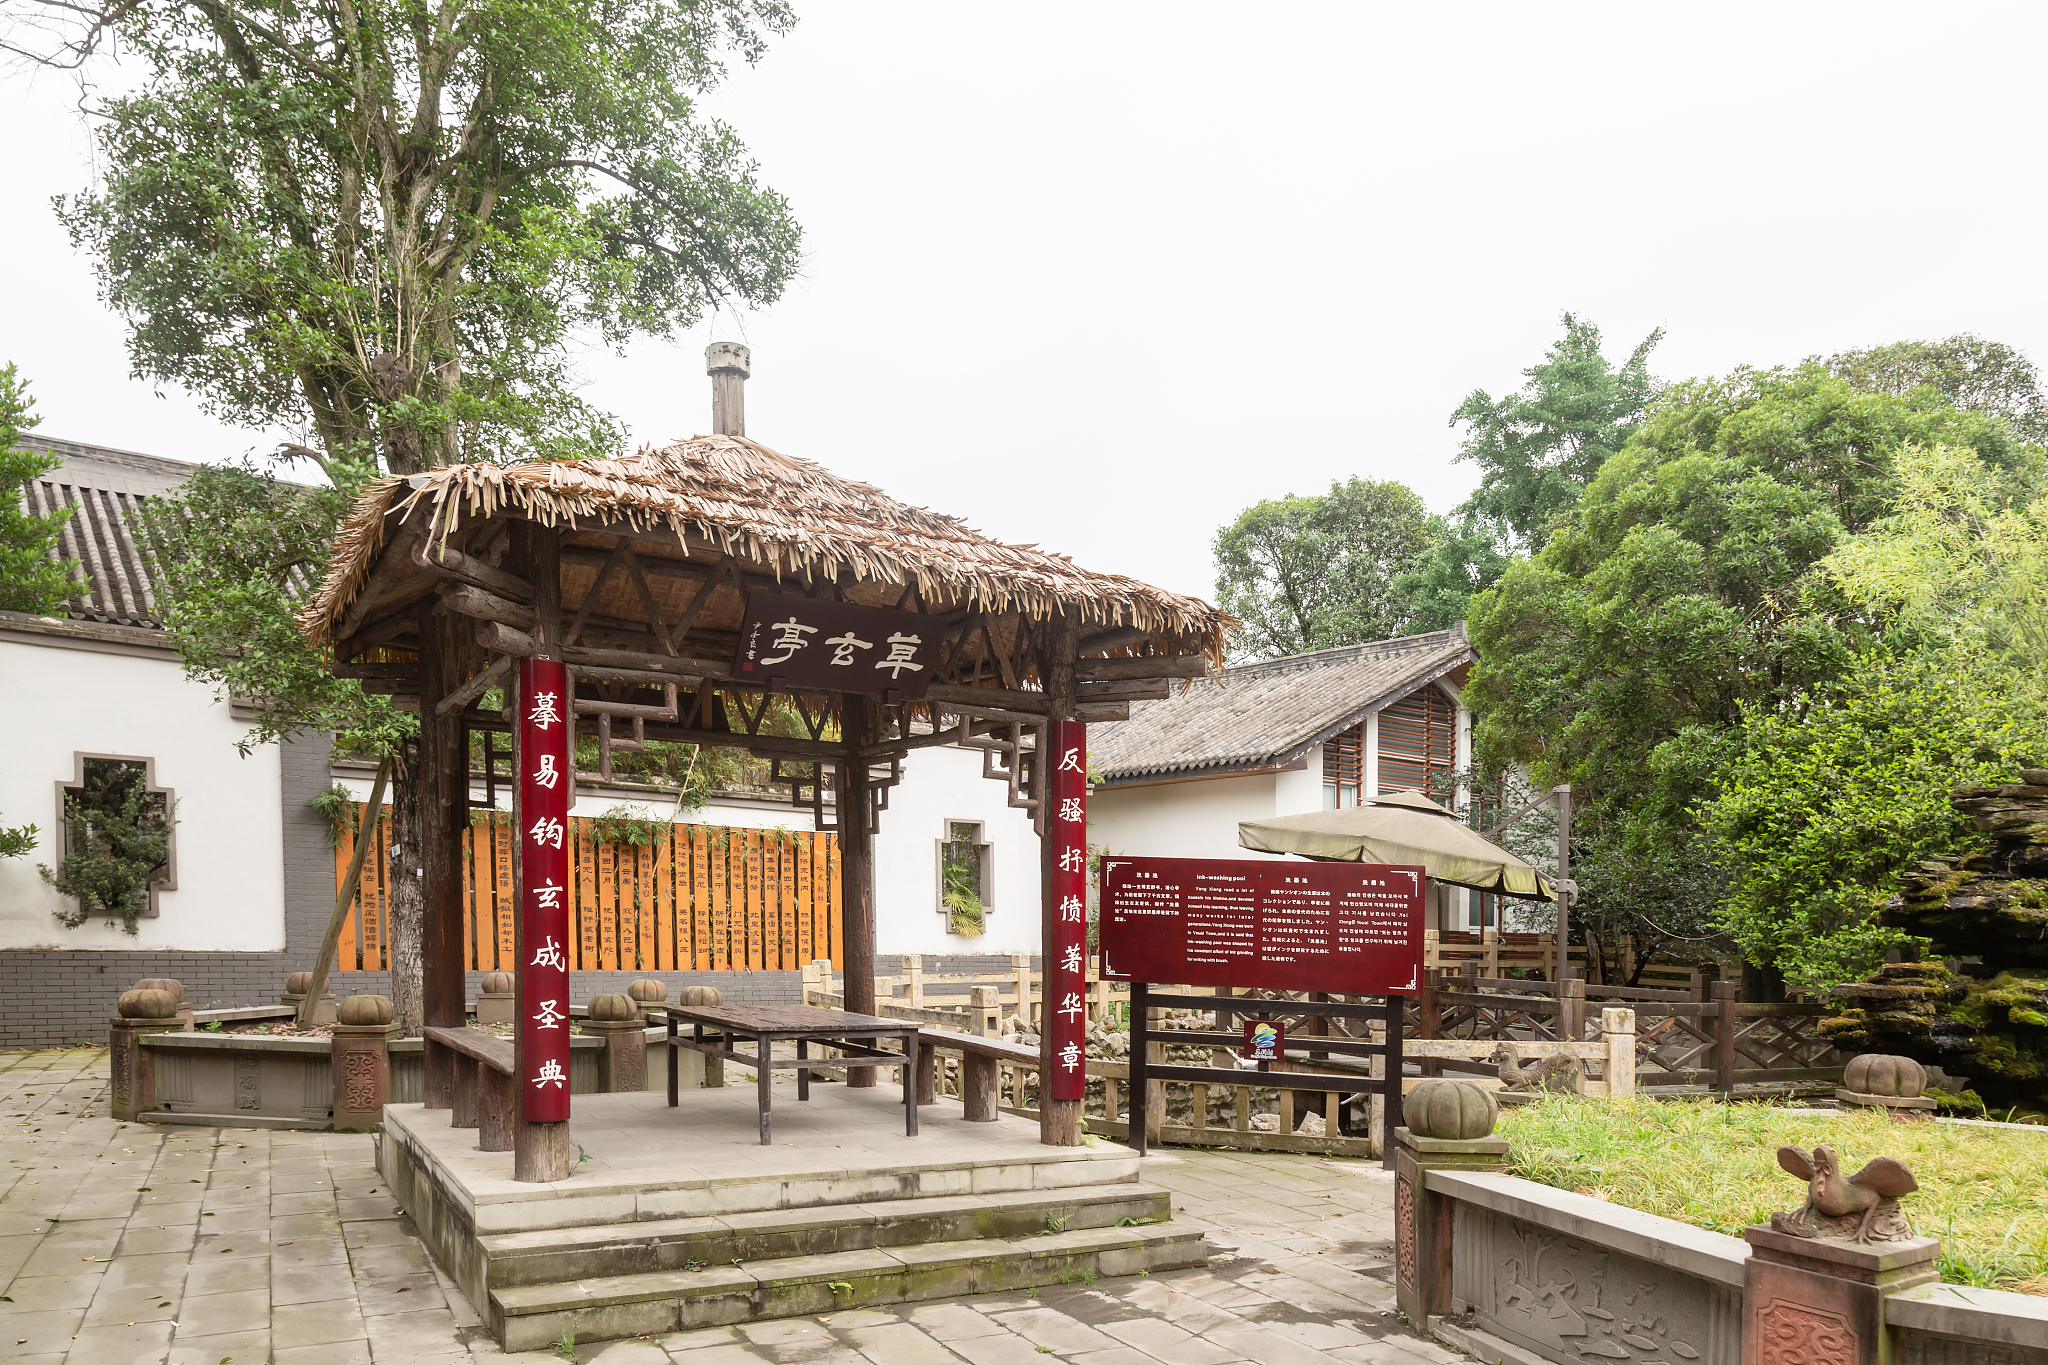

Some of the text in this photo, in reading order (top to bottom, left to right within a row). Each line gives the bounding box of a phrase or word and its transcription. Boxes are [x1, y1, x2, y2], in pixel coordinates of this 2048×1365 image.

[527, 691, 567, 1089] 摹易钩玄成圣典
[1057, 748, 1084, 1074] 反骚抒愤著华章
